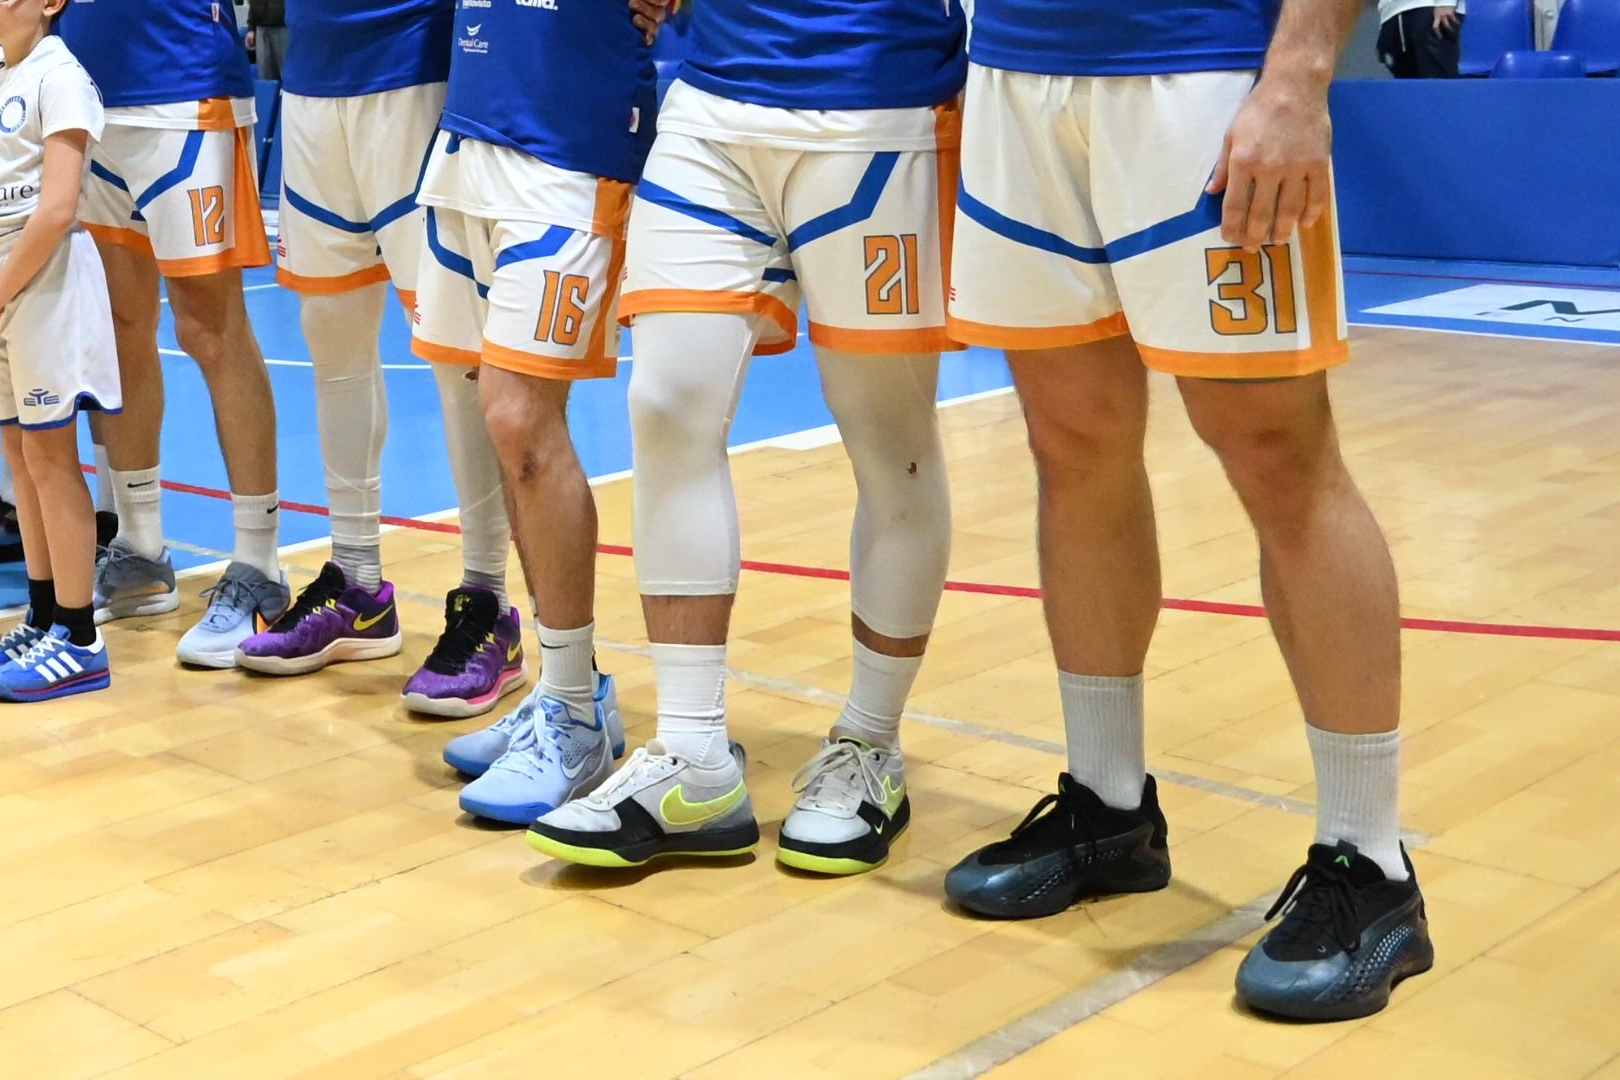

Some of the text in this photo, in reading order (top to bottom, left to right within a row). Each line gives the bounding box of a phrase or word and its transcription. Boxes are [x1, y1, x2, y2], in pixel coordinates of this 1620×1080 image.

[185, 185, 225, 247] 12
[535, 269, 590, 345] 16
[863, 233, 920, 315] 21
[1204, 243, 1297, 336] 31
